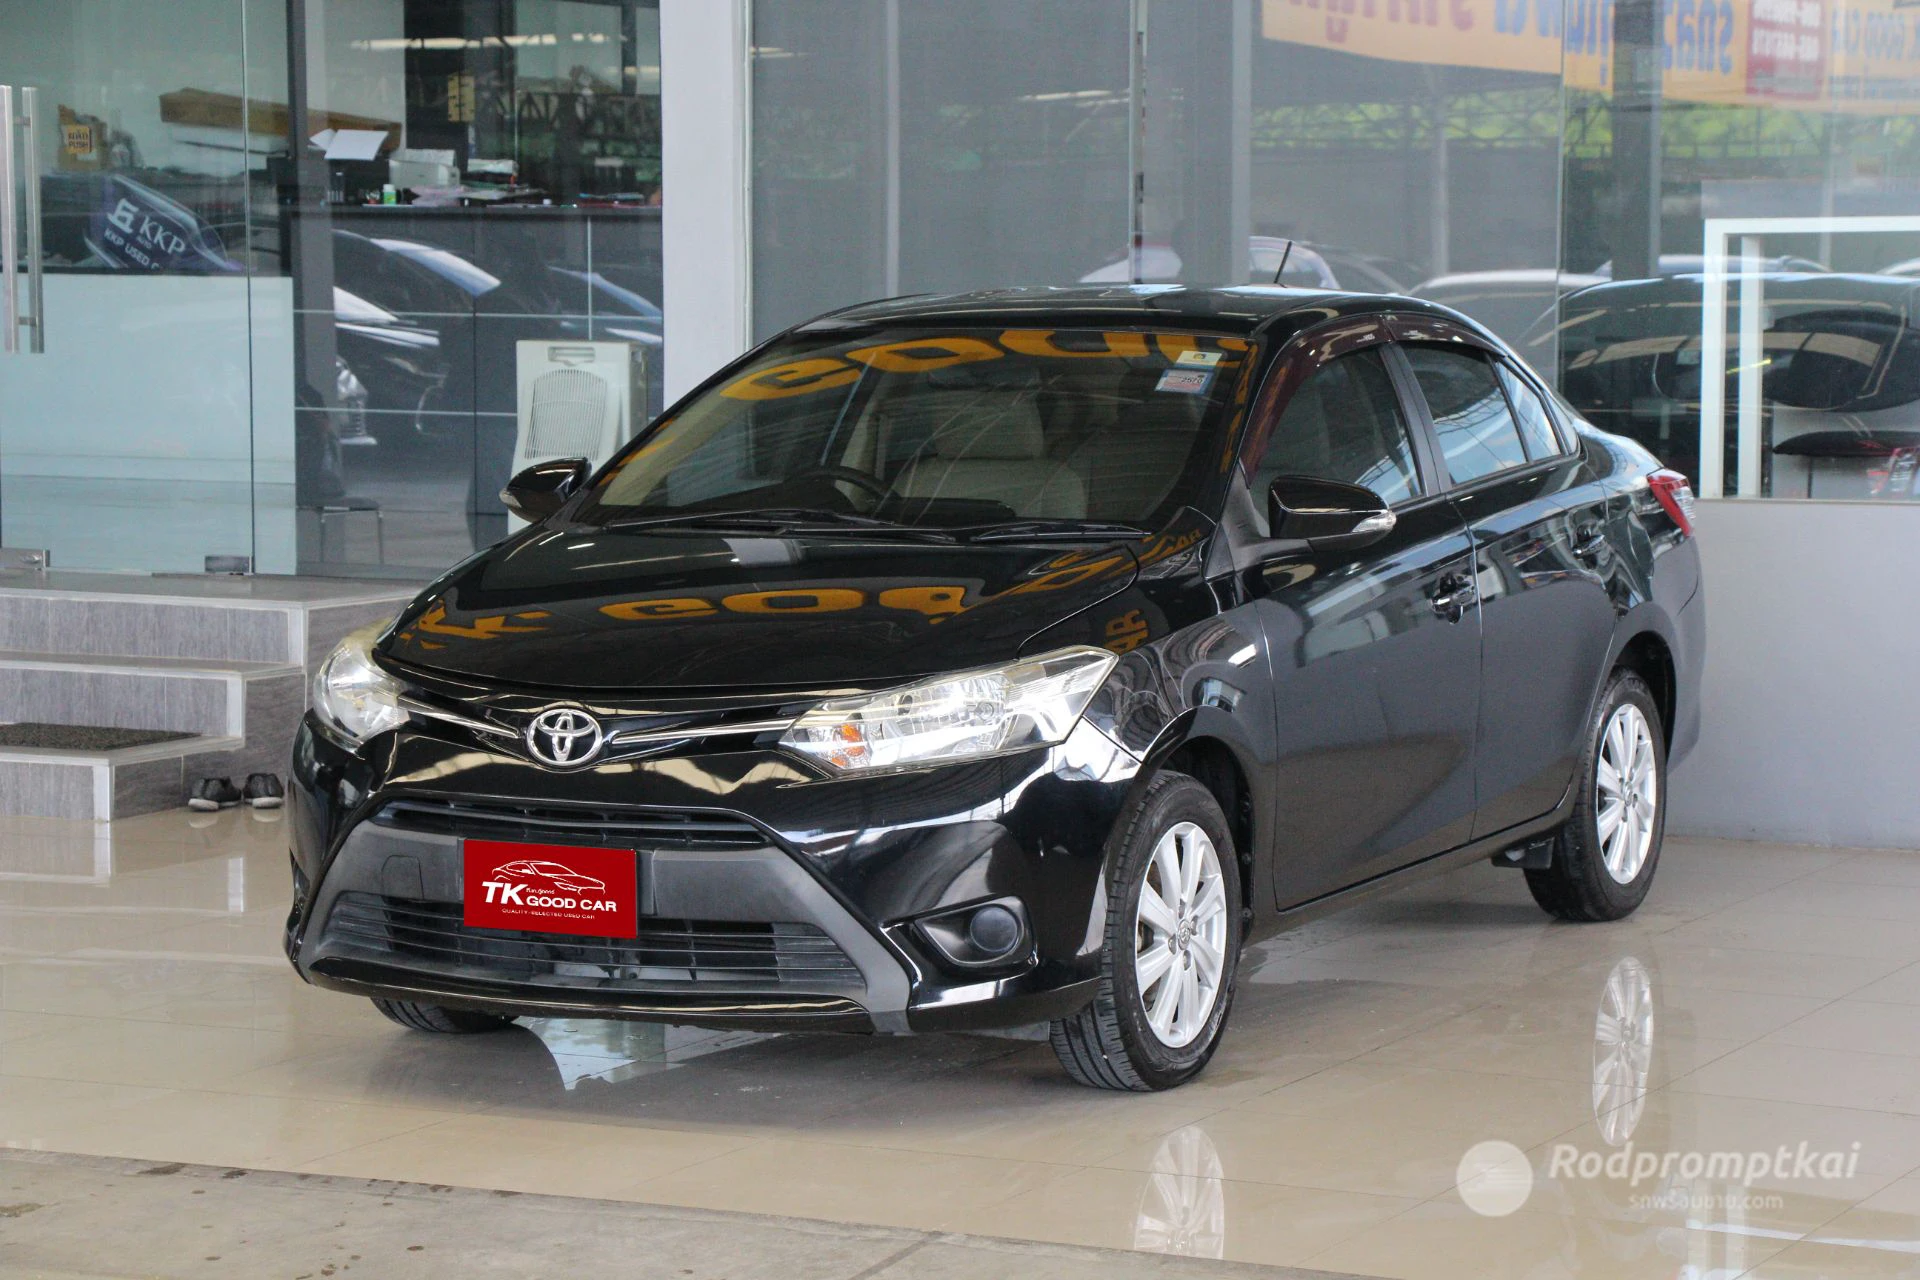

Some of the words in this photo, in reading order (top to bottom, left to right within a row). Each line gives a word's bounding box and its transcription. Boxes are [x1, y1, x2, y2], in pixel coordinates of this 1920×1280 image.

[104, 228, 125, 246] KKP
[125, 243, 150, 266] USED
[140, 215, 186, 255] KKP
[481, 881, 528, 905] TK
[526, 895, 577, 909] GOOD
[580, 899, 618, 913] CAR
